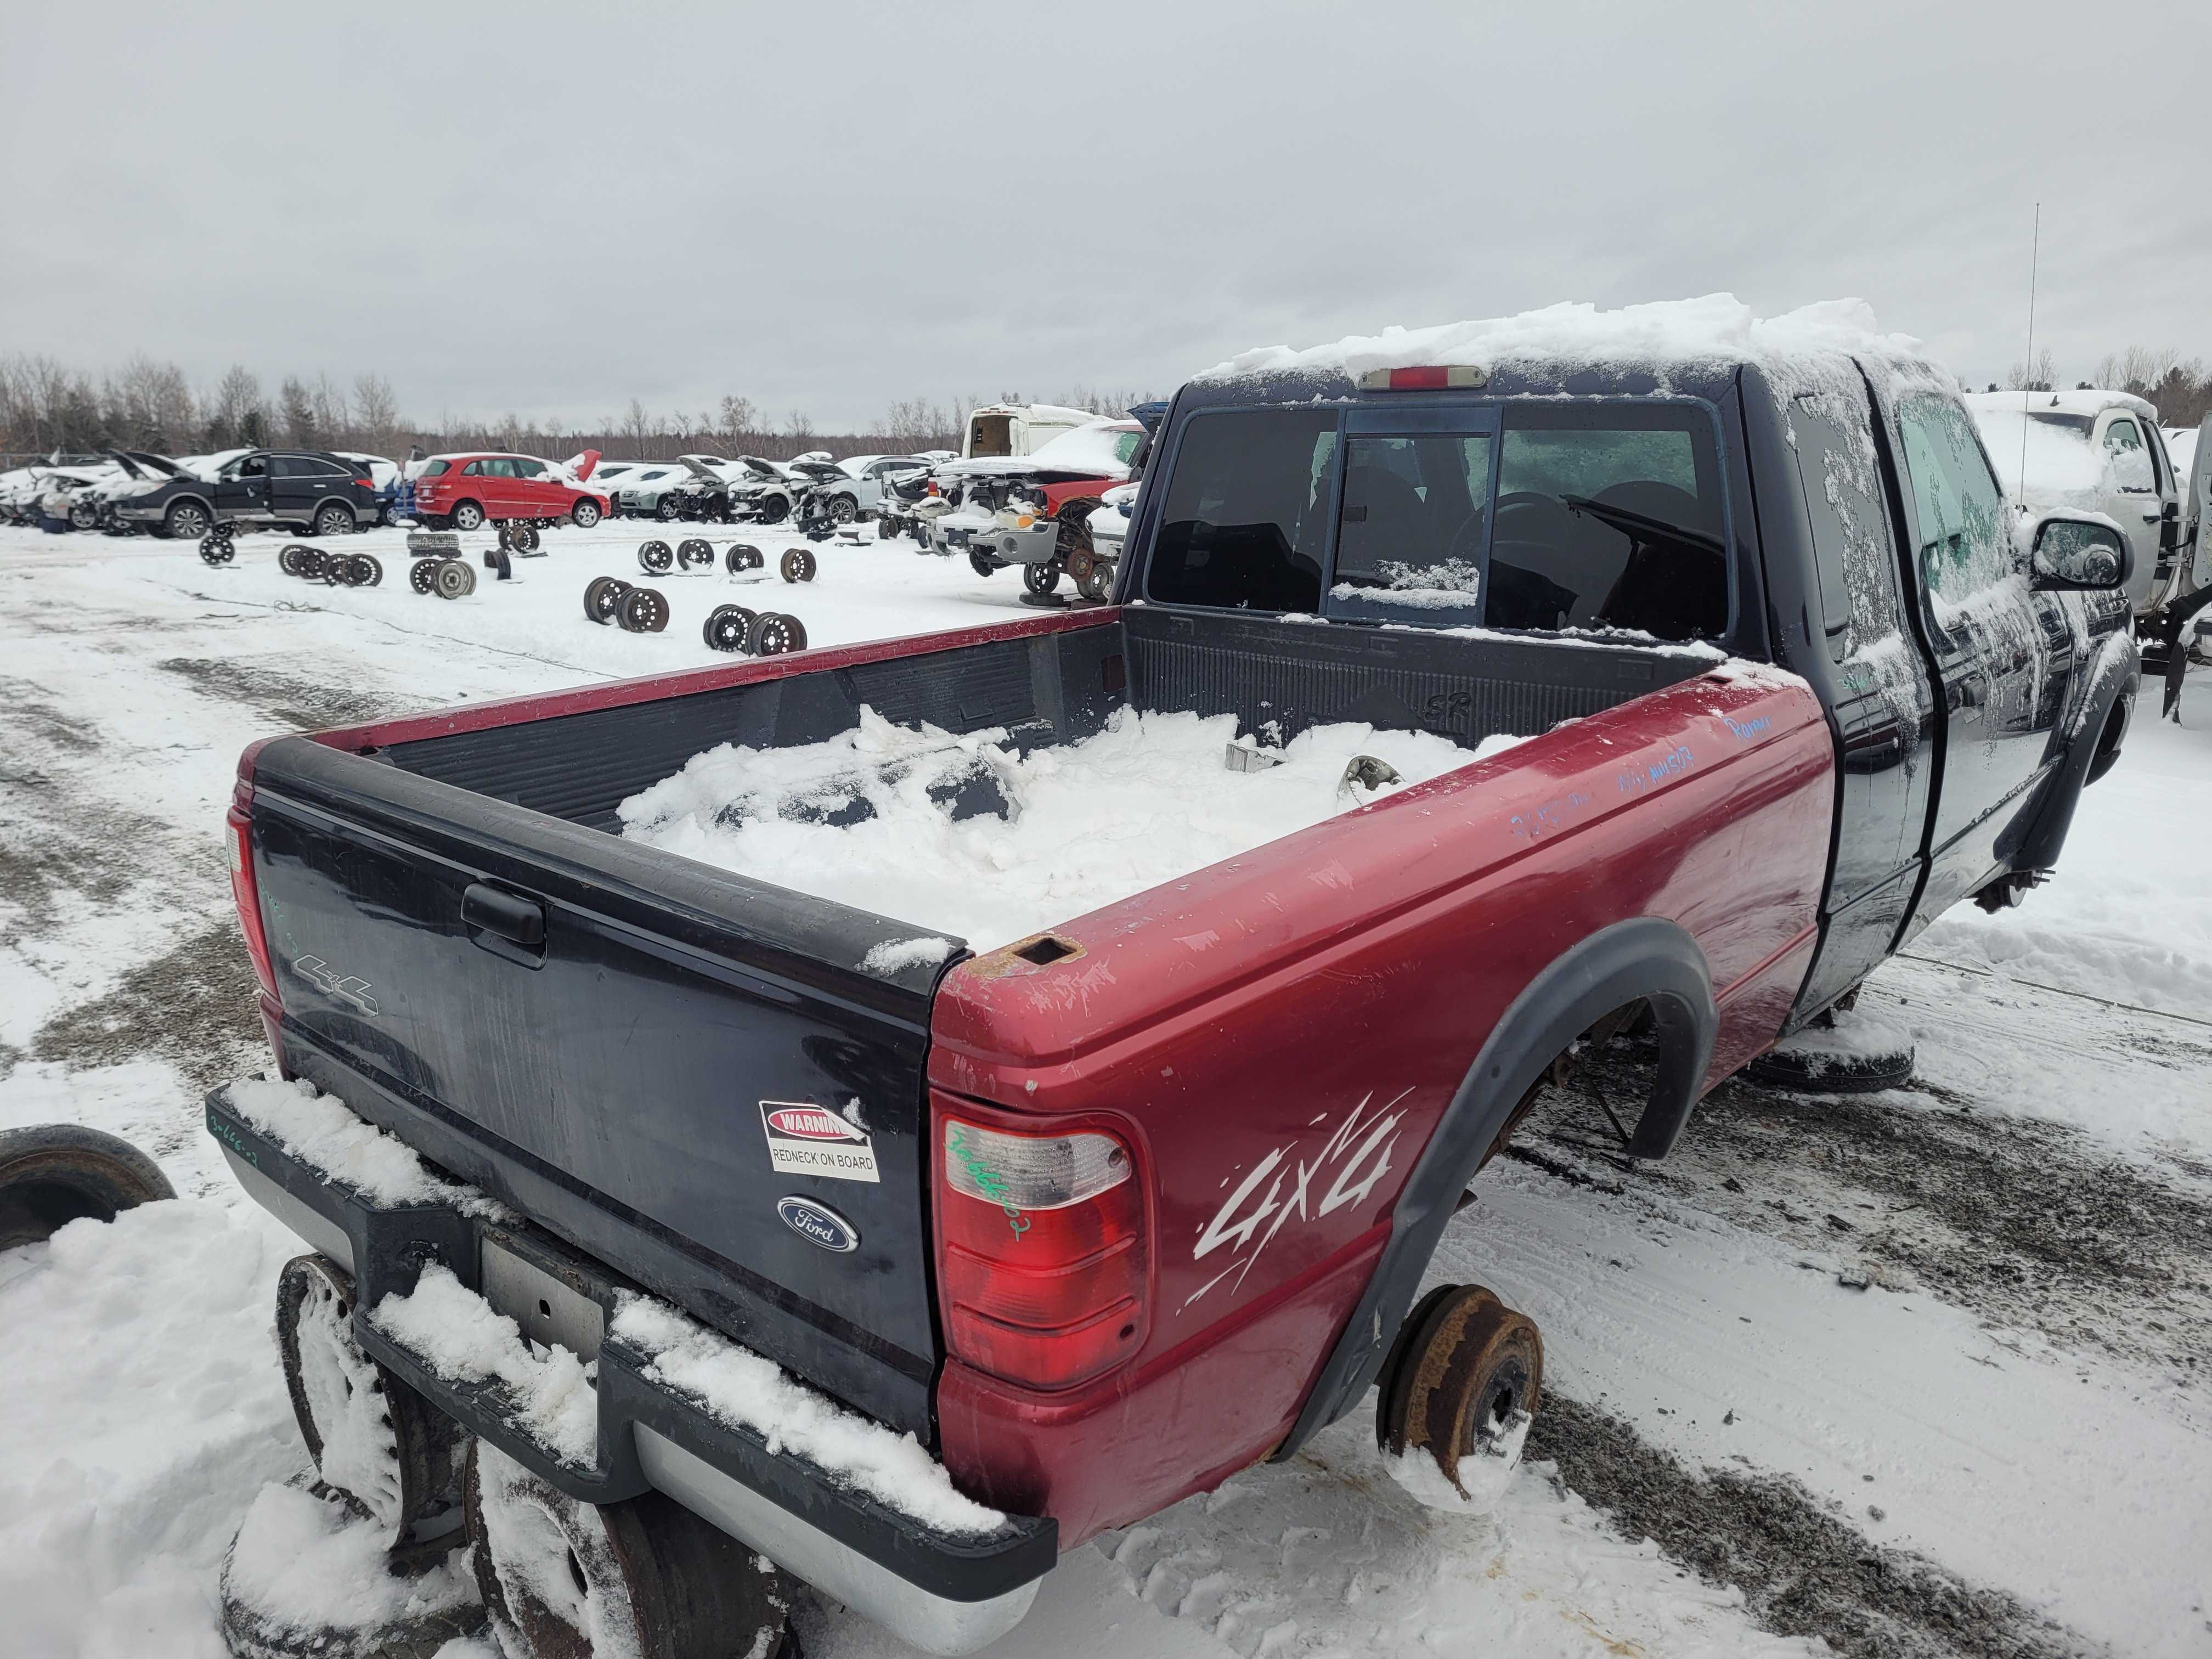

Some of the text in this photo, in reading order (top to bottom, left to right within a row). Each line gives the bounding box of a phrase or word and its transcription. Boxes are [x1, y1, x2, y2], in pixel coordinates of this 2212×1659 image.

[779, 1113, 849, 1135] WARNIN
[772, 1148, 873, 1170] REDNECK ON BOARD
[795, 1209, 834, 1242] Ford
